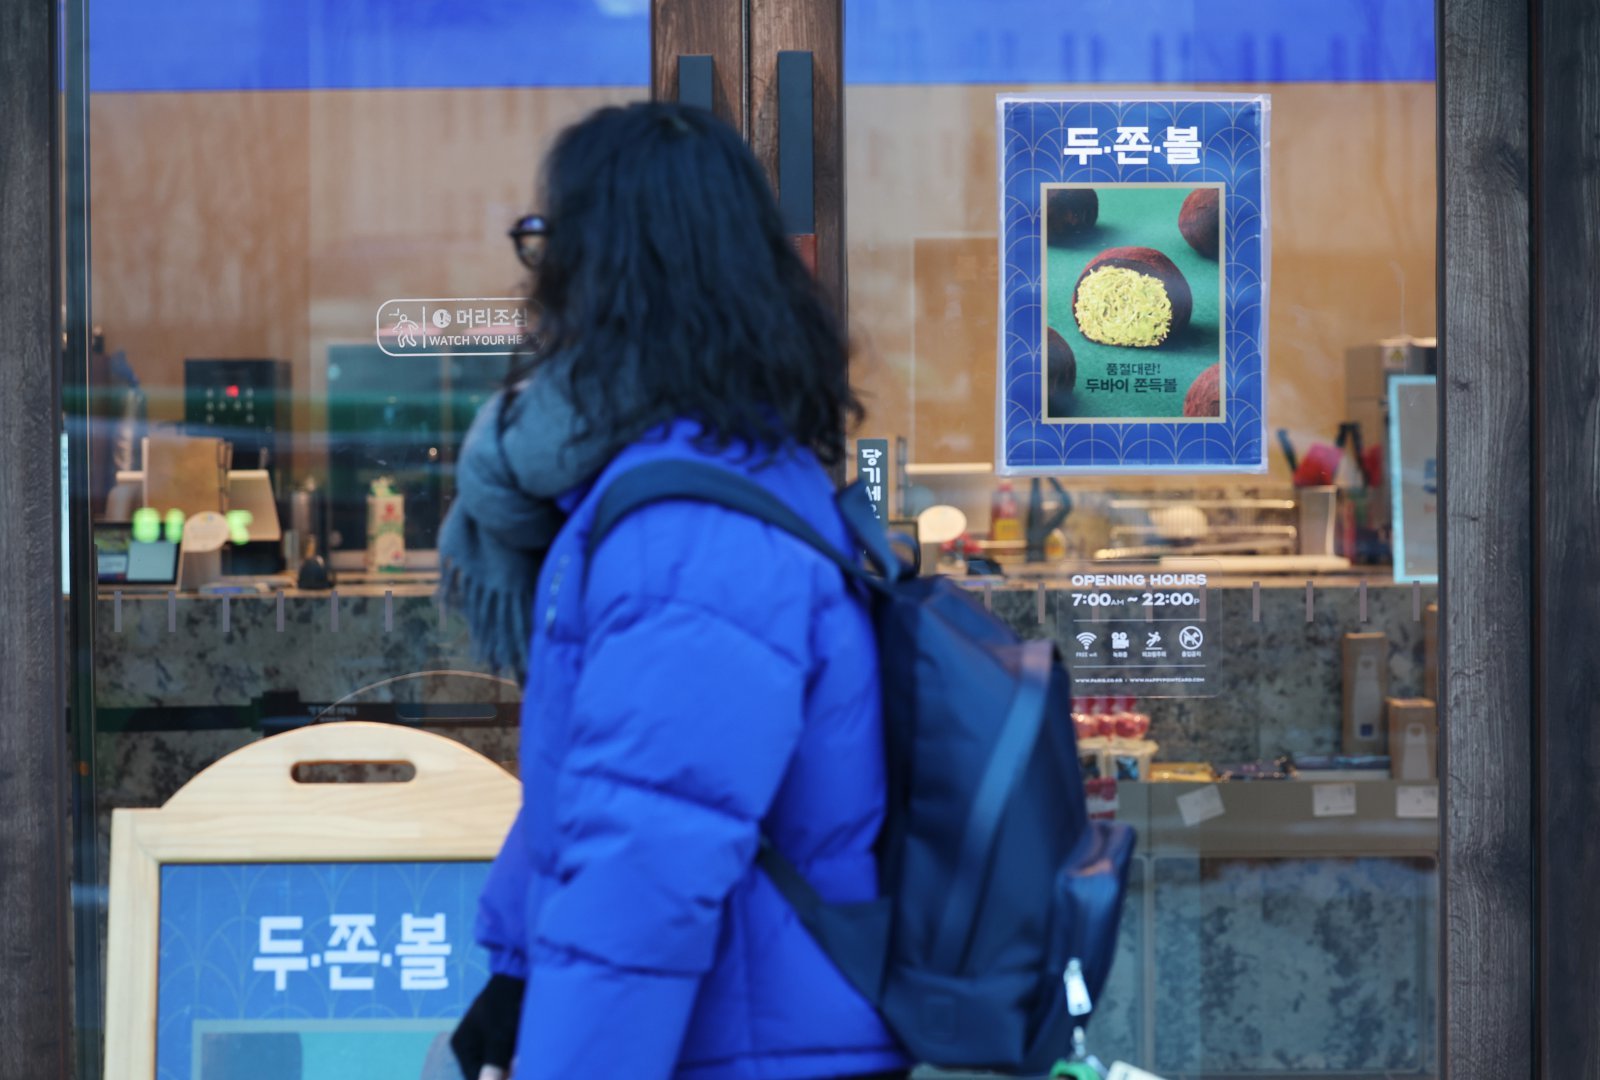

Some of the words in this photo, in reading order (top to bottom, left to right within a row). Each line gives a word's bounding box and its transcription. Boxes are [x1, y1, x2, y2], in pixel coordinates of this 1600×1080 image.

[1063, 126, 1203, 166] 두·쫀·볼
[456, 308, 528, 328] 머리조심
[429, 336, 470, 346] WATCH
[473, 335, 505, 346] YOUR
[508, 335, 531, 345] HE
[1106, 363, 1161, 376] 품절대란!
[1086, 378, 1129, 393] 두바이
[1134, 378, 1178, 393] 쫀득볼
[1071, 574, 1145, 586] OPENING
[1150, 574, 1207, 586] HOURS
[253, 913, 451, 990] 두·쫀·볼
